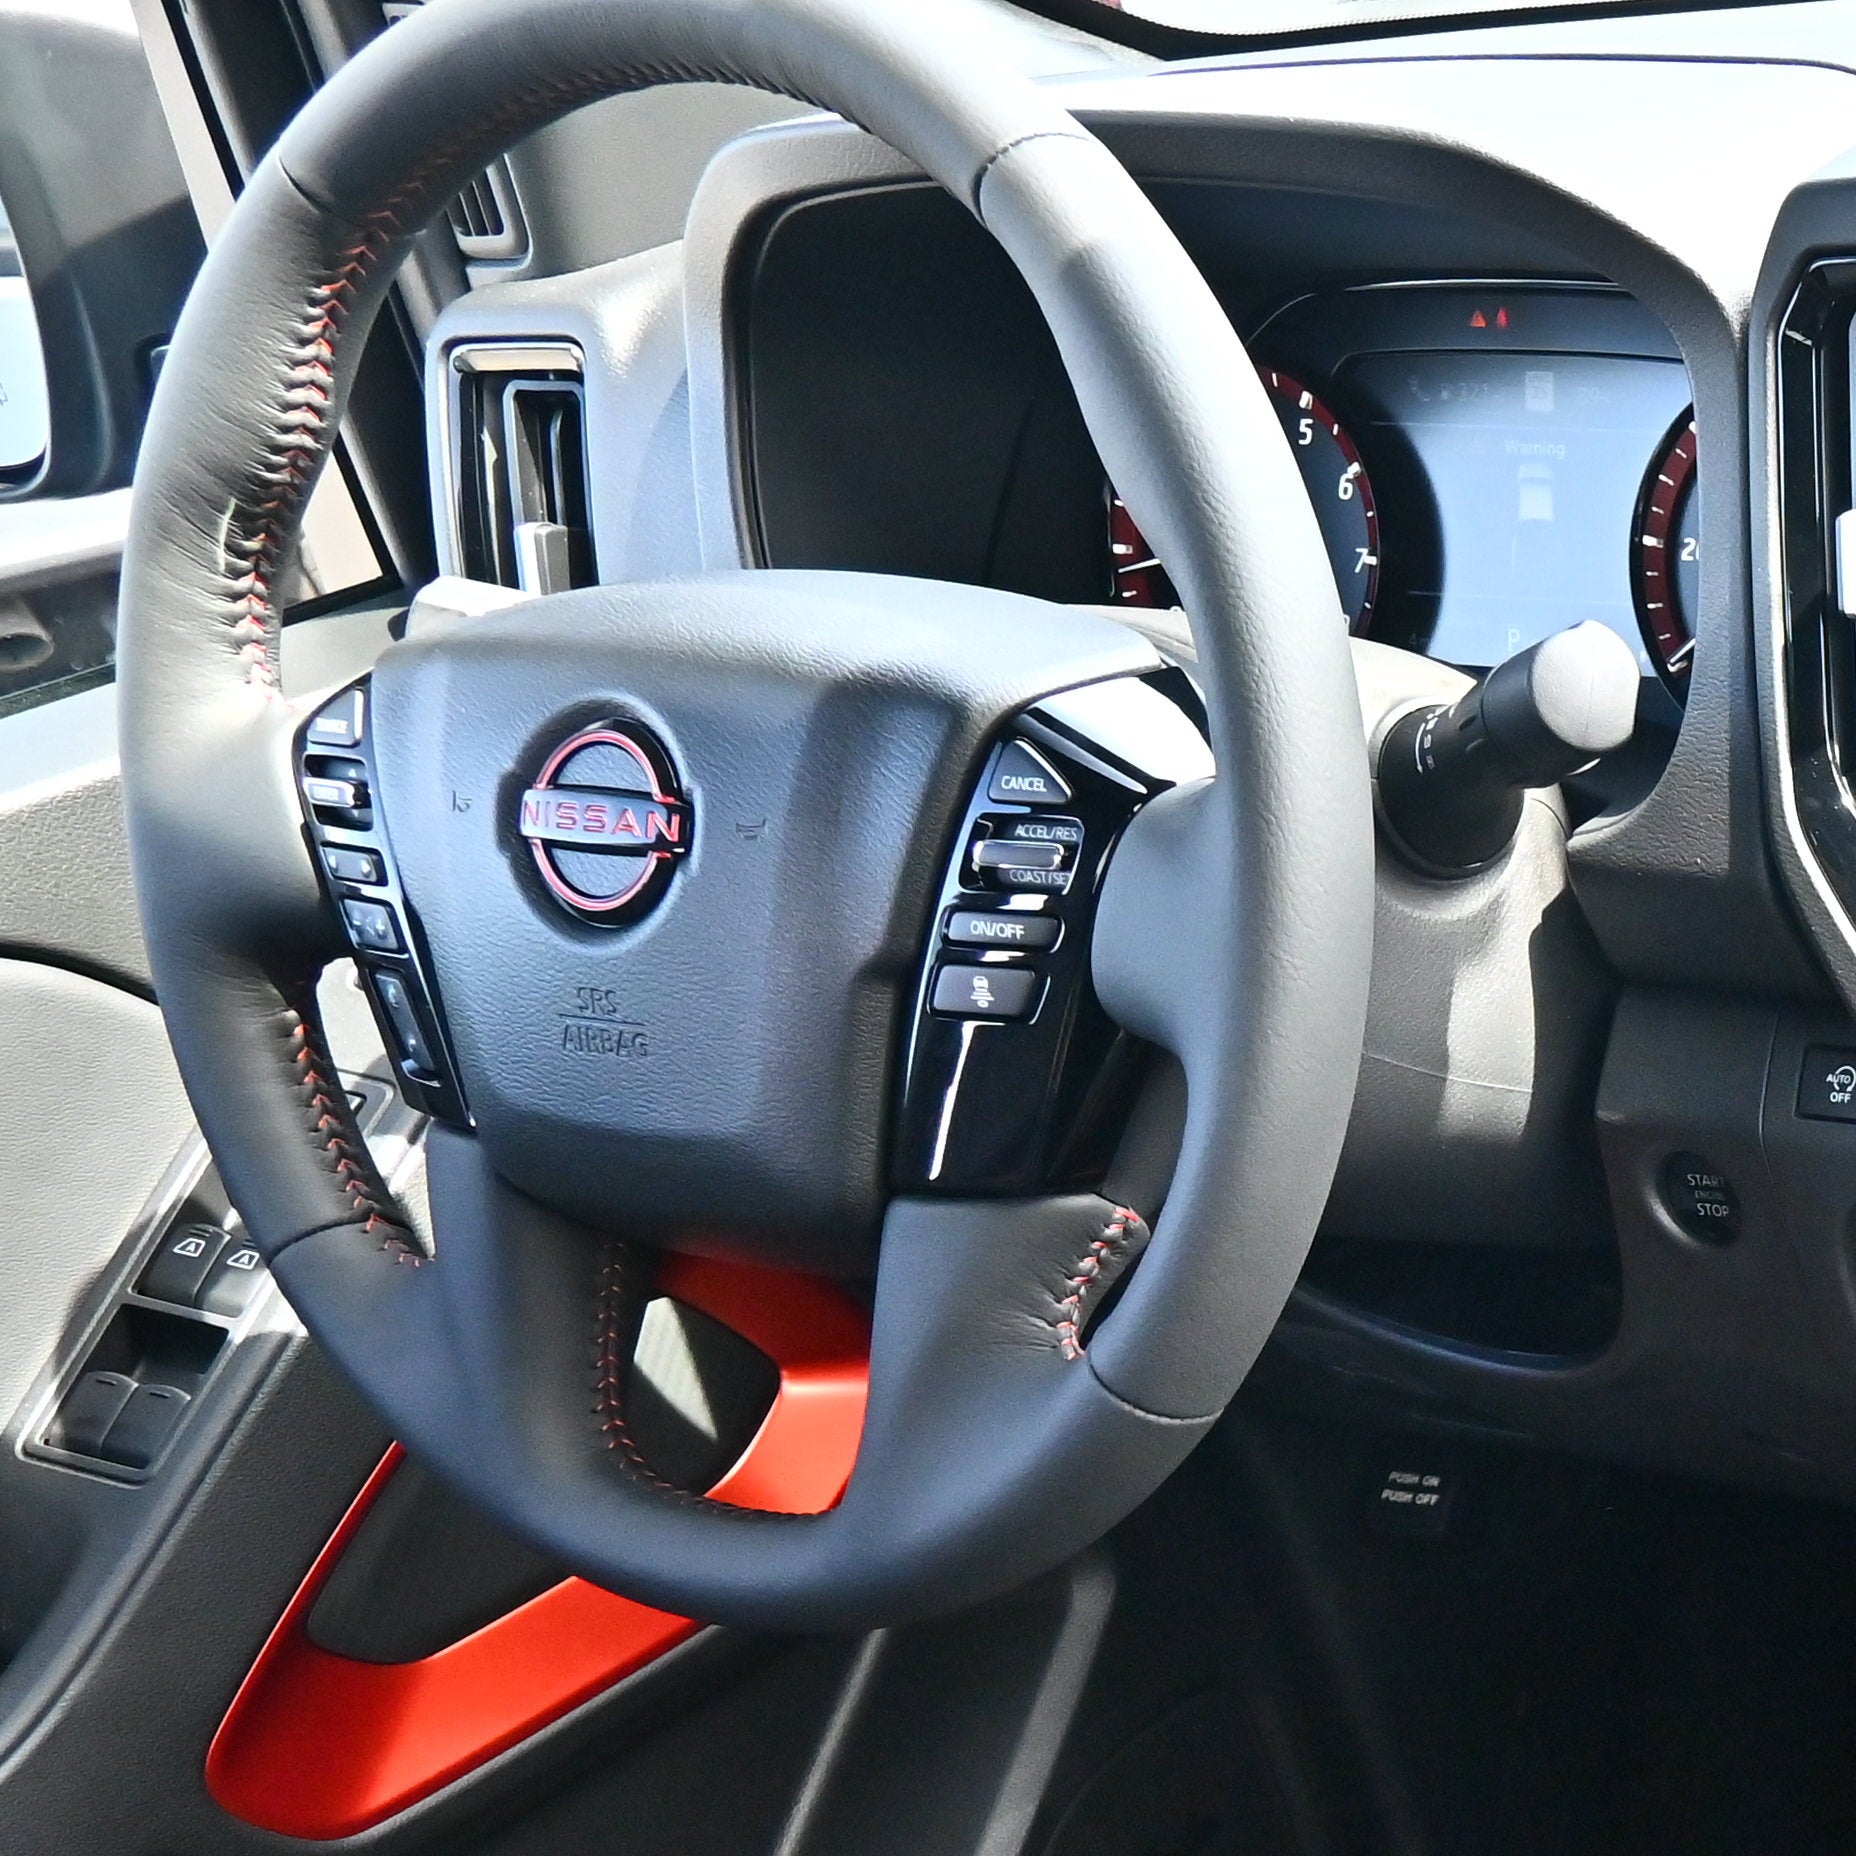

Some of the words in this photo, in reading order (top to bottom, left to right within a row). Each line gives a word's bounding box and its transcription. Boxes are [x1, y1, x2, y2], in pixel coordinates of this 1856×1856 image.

[1299, 418, 1313, 445] 5
[1338, 472, 1354, 501] 6
[1001, 776, 1047, 793] CANCEL
[523, 801, 680, 842] NISSAN
[1014, 824, 1078, 840] ACCEL/RES
[1010, 870, 1070, 886] COAST/SET
[970, 922, 1025, 940] ON/OFF
[1826, 1073, 1851, 1084] AUTO
[1830, 1092, 1851, 1104] OFF
[1687, 1174, 1725, 1186] START
[1697, 1203, 1729, 1217] STOP
[1415, 1493, 1439, 1506] OFF
